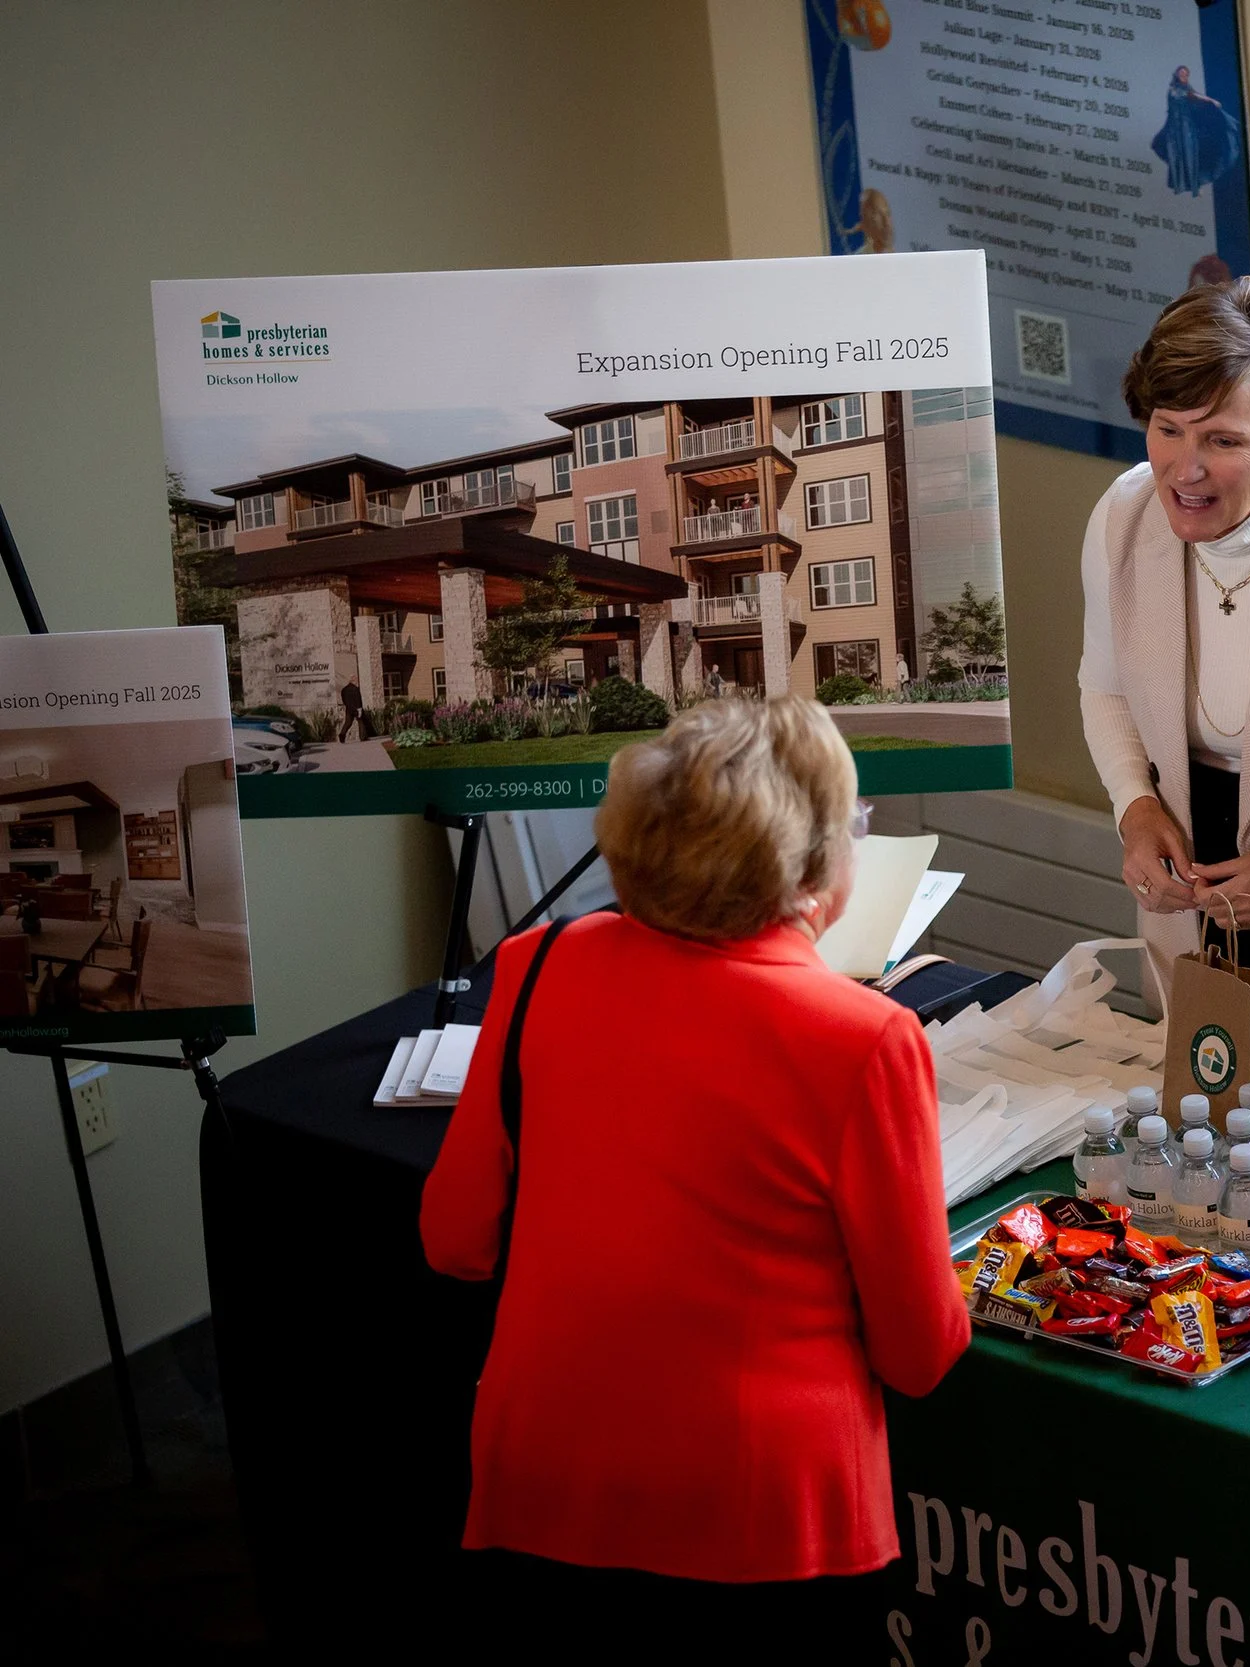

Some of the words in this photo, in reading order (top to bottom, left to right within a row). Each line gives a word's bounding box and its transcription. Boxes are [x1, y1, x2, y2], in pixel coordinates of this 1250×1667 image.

[991, 2, 1034, 22] Summit
[1046, 14, 1088, 36] January
[1108, 25, 1135, 41] 2026
[1135, 6, 1163, 20] 2026
[944, 20, 976, 37] Julian
[978, 28, 1003, 44] Lage
[1014, 34, 1056, 56] January
[1076, 45, 1101, 61] 2026
[920, 42, 976, 63] Hollywood
[979, 53, 1029, 73] Revisited
[1040, 64, 1089, 88] February
[1104, 77, 1130, 92] 2026
[979, 103, 1013, 121] Cohen
[1024, 113, 1073, 136] February
[1093, 126, 1119, 142] 2026
[1034, 90, 1085, 112] February
[1103, 102, 1130, 118] 2026
[911, 116, 974, 142] Celebrating
[976, 128, 1013, 150] Sammy
[1016, 138, 1046, 154] Davis
[1074, 149, 1108, 166] March
[1126, 158, 1153, 174] 2026
[955, 149, 974, 162] and
[996, 158, 1049, 180] Alexander
[1062, 171, 1096, 190] March
[1114, 183, 1142, 198] 2026
[904, 166, 912, 177] &
[960, 176, 990, 194] Years
[992, 183, 1005, 195] of
[1006, 184, 1064, 211] Friendship
[1068, 200, 1087, 214] and
[1132, 212, 1160, 229] April
[1180, 222, 1206, 237] 2026
[940, 198, 973, 214] Donna
[1020, 214, 1054, 235] Group
[1066, 223, 1094, 241] April
[1110, 232, 1136, 248] 2026
[947, 224, 969, 239] Sam
[1020, 240, 1059, 259] Project
[1070, 250, 1092, 266] May
[1106, 258, 1132, 273] 2026
[1016, 263, 1050, 284] String
[1052, 272, 1095, 291] Quartet
[1104, 283, 1128, 301] May
[202, 342, 249, 358] homes
[254, 343, 263, 358] &
[269, 342, 330, 357] services
[247, 323, 328, 343] presbyterian
[577, 348, 713, 377] Expansion
[720, 343, 828, 372] Opening
[836, 339, 882, 362] Fall
[890, 336, 948, 360] 2025
[206, 374, 254, 386] Dickson
[256, 373, 299, 384] Hollow
[275, 664, 302, 673] Dickson
[304, 662, 330, 672] Hollow
[45, 690, 119, 711] Opening
[124, 687, 155, 703] Fall
[160, 685, 201, 701] 2025
[466, 780, 572, 798] 262-599-8300
[1200, 1027, 1214, 1038] Treat
